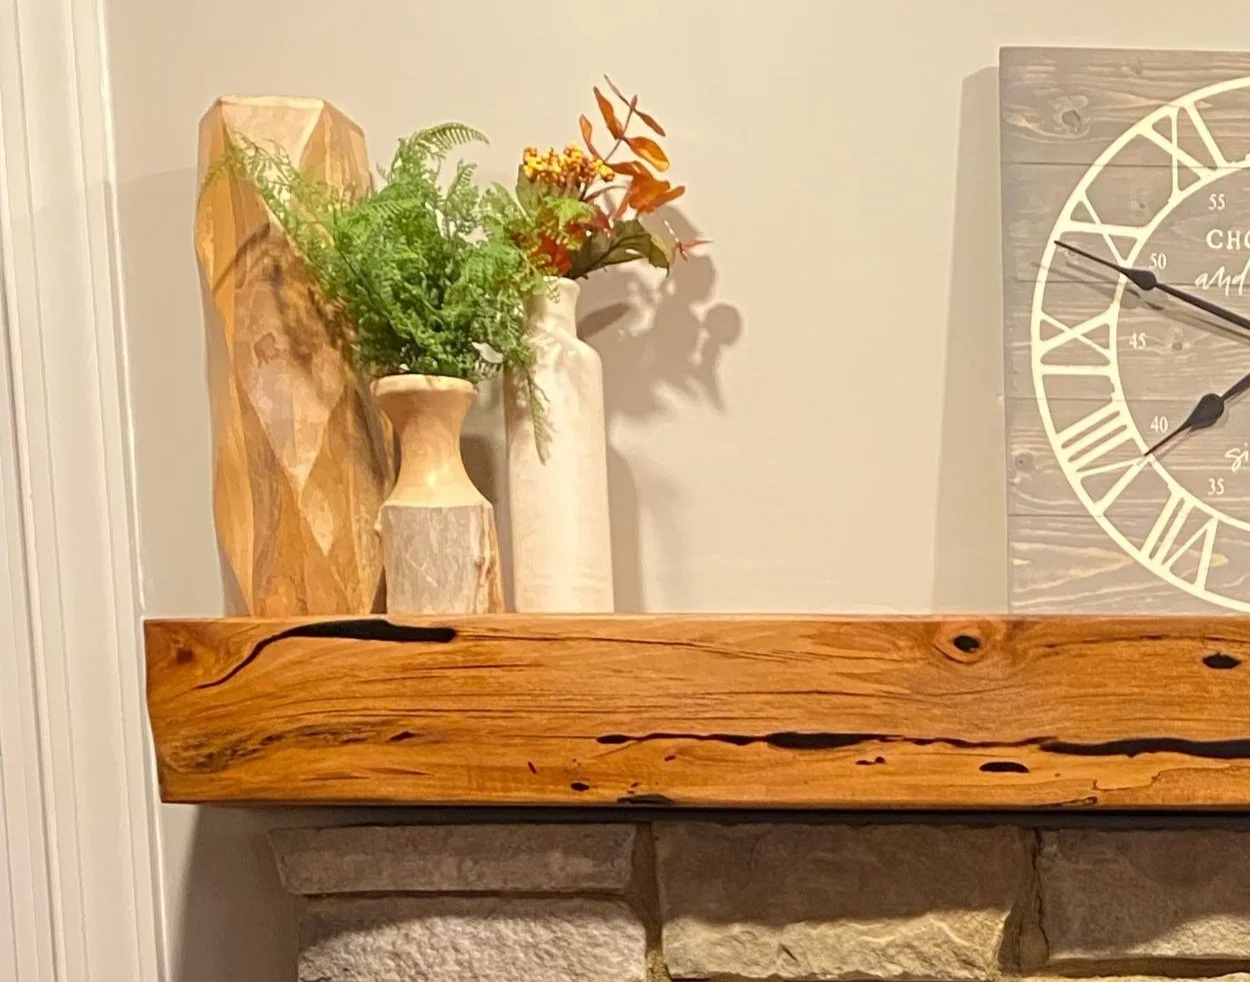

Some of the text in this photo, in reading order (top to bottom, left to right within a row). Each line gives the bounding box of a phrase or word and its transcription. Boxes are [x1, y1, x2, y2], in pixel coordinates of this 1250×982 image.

[1208, 193, 1226, 211] 55
[1149, 252, 1167, 270] 50
[1128, 331, 1147, 349] 45
[1150, 415, 1169, 433] 40
[1207, 477, 1225, 496] 35
